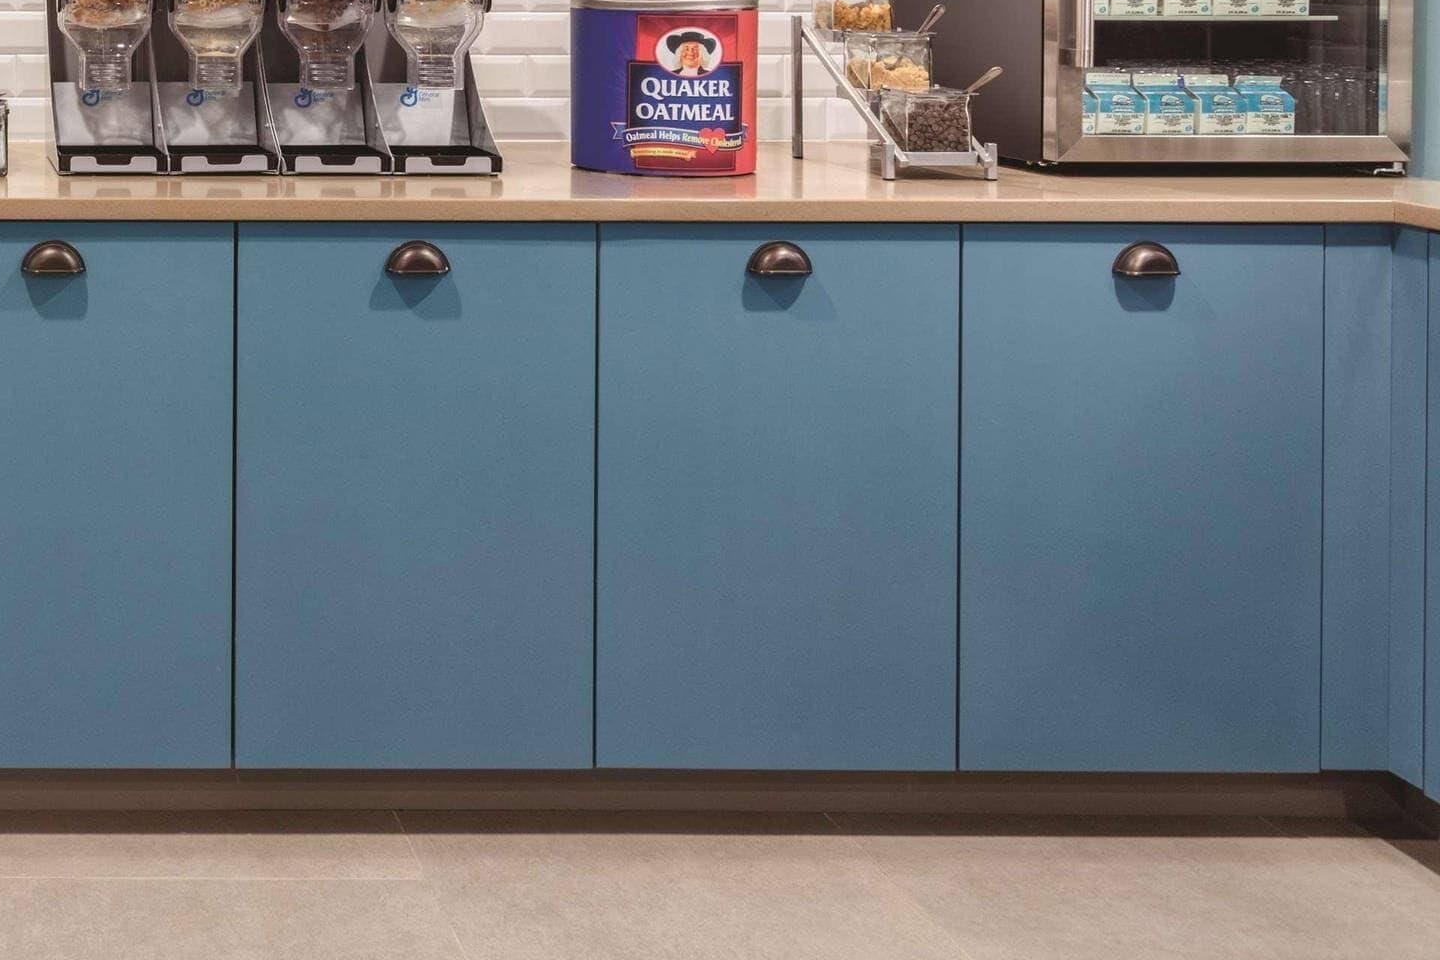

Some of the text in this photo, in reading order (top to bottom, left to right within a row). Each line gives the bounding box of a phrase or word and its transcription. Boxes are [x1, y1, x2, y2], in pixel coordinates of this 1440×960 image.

[641, 77, 733, 100] QUAKER
[635, 103, 734, 121] OATMEAL
[626, 130, 657, 142] Oatmeal
[658, 130, 681, 142] Helps
[682, 132, 710, 145] Remove
